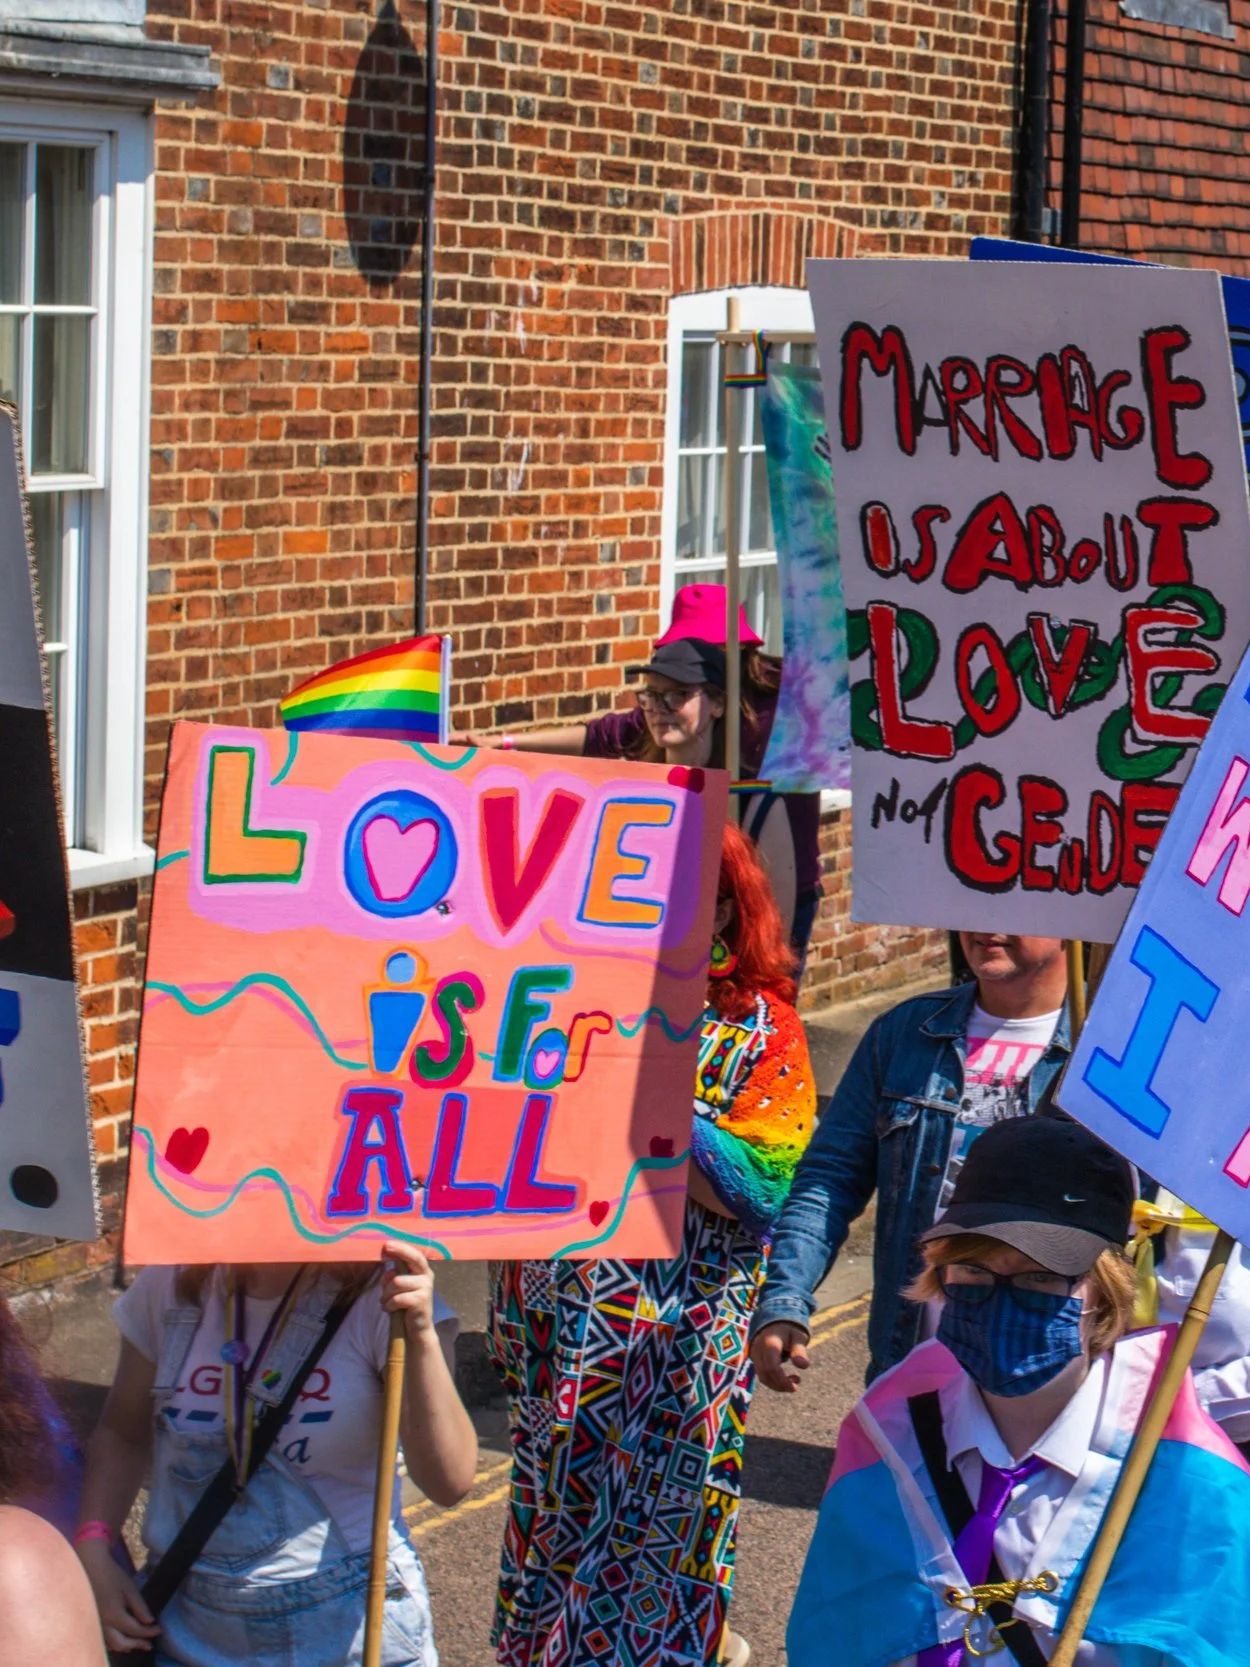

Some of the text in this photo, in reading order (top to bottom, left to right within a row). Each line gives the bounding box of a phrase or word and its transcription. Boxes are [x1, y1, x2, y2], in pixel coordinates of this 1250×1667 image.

[840, 321, 1212, 489] MARRIAGE
[942, 491, 1220, 593] ABOUT
[866, 600, 1222, 760] LOVE
[202, 744, 678, 938] LOVE
[325, 1086, 578, 1220] ALL
